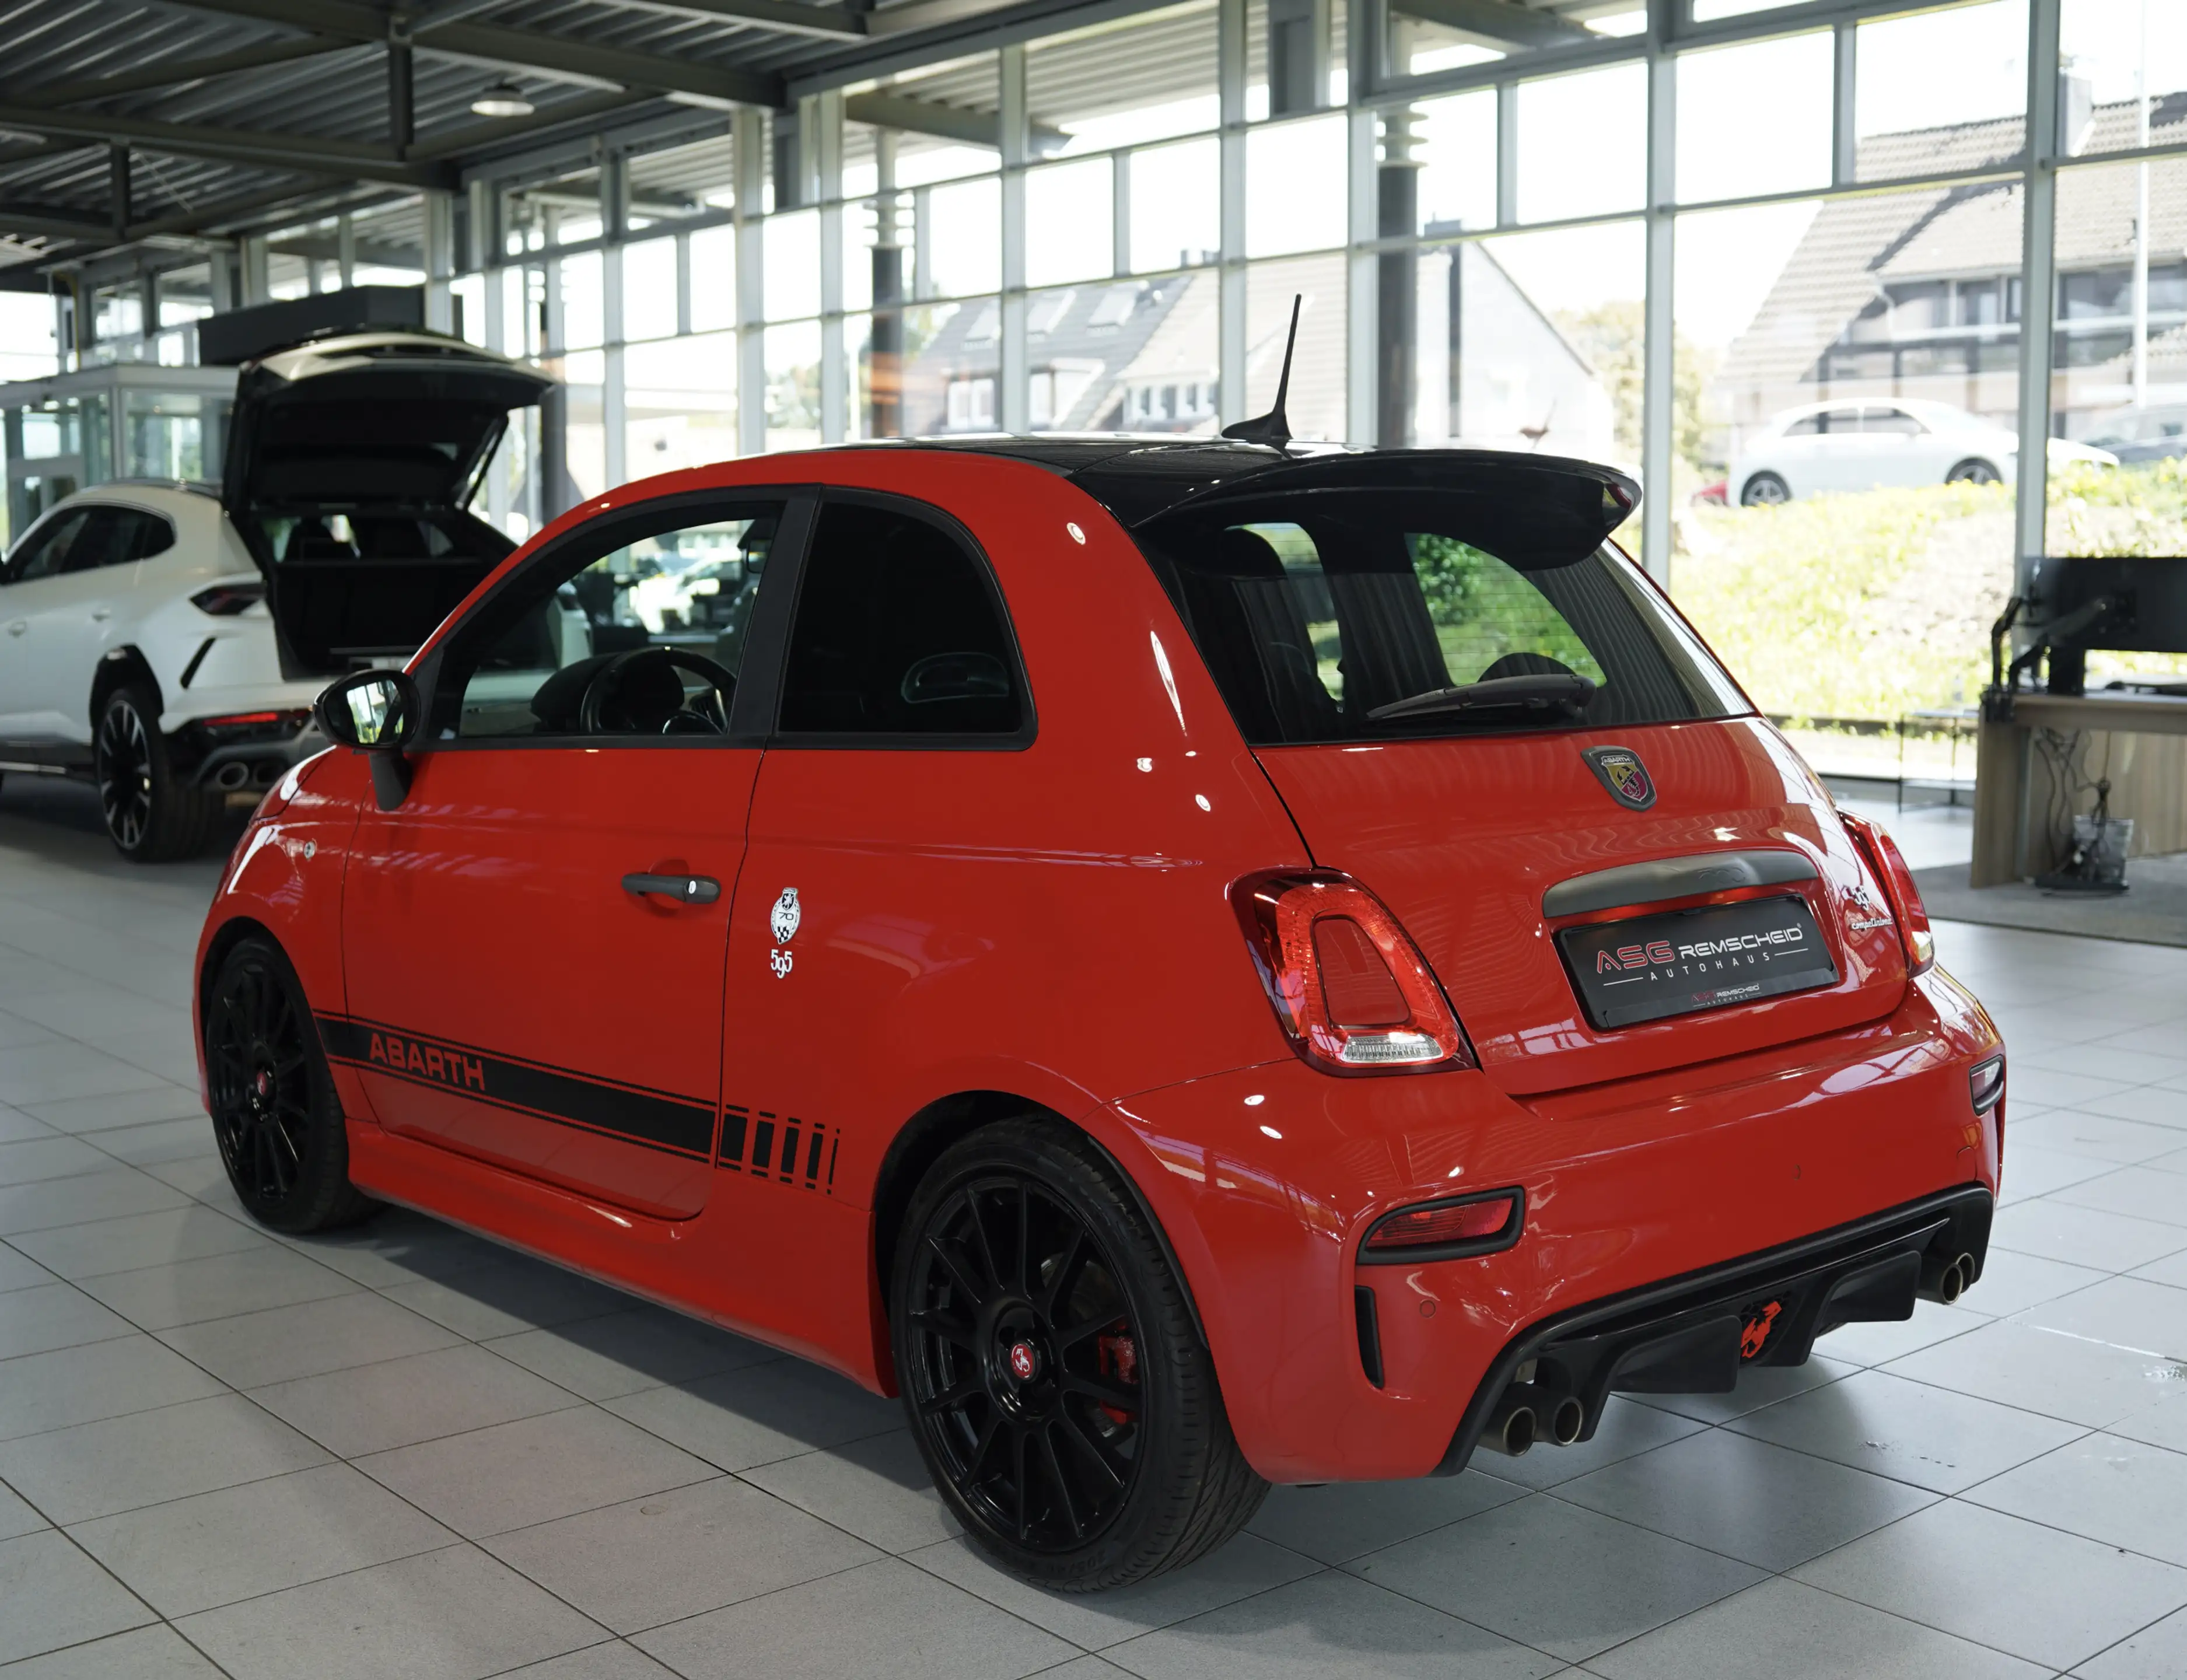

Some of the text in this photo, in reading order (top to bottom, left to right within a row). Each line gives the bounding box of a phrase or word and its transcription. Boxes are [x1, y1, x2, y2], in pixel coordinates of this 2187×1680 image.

[778, 912, 794, 921] 70
[770, 949, 793, 979] 595
[1597, 927, 1803, 974] ASG REMSCHEID
[1650, 952, 1770, 981] AUTOHAUS
[369, 1032, 485, 1091] ABARTH
